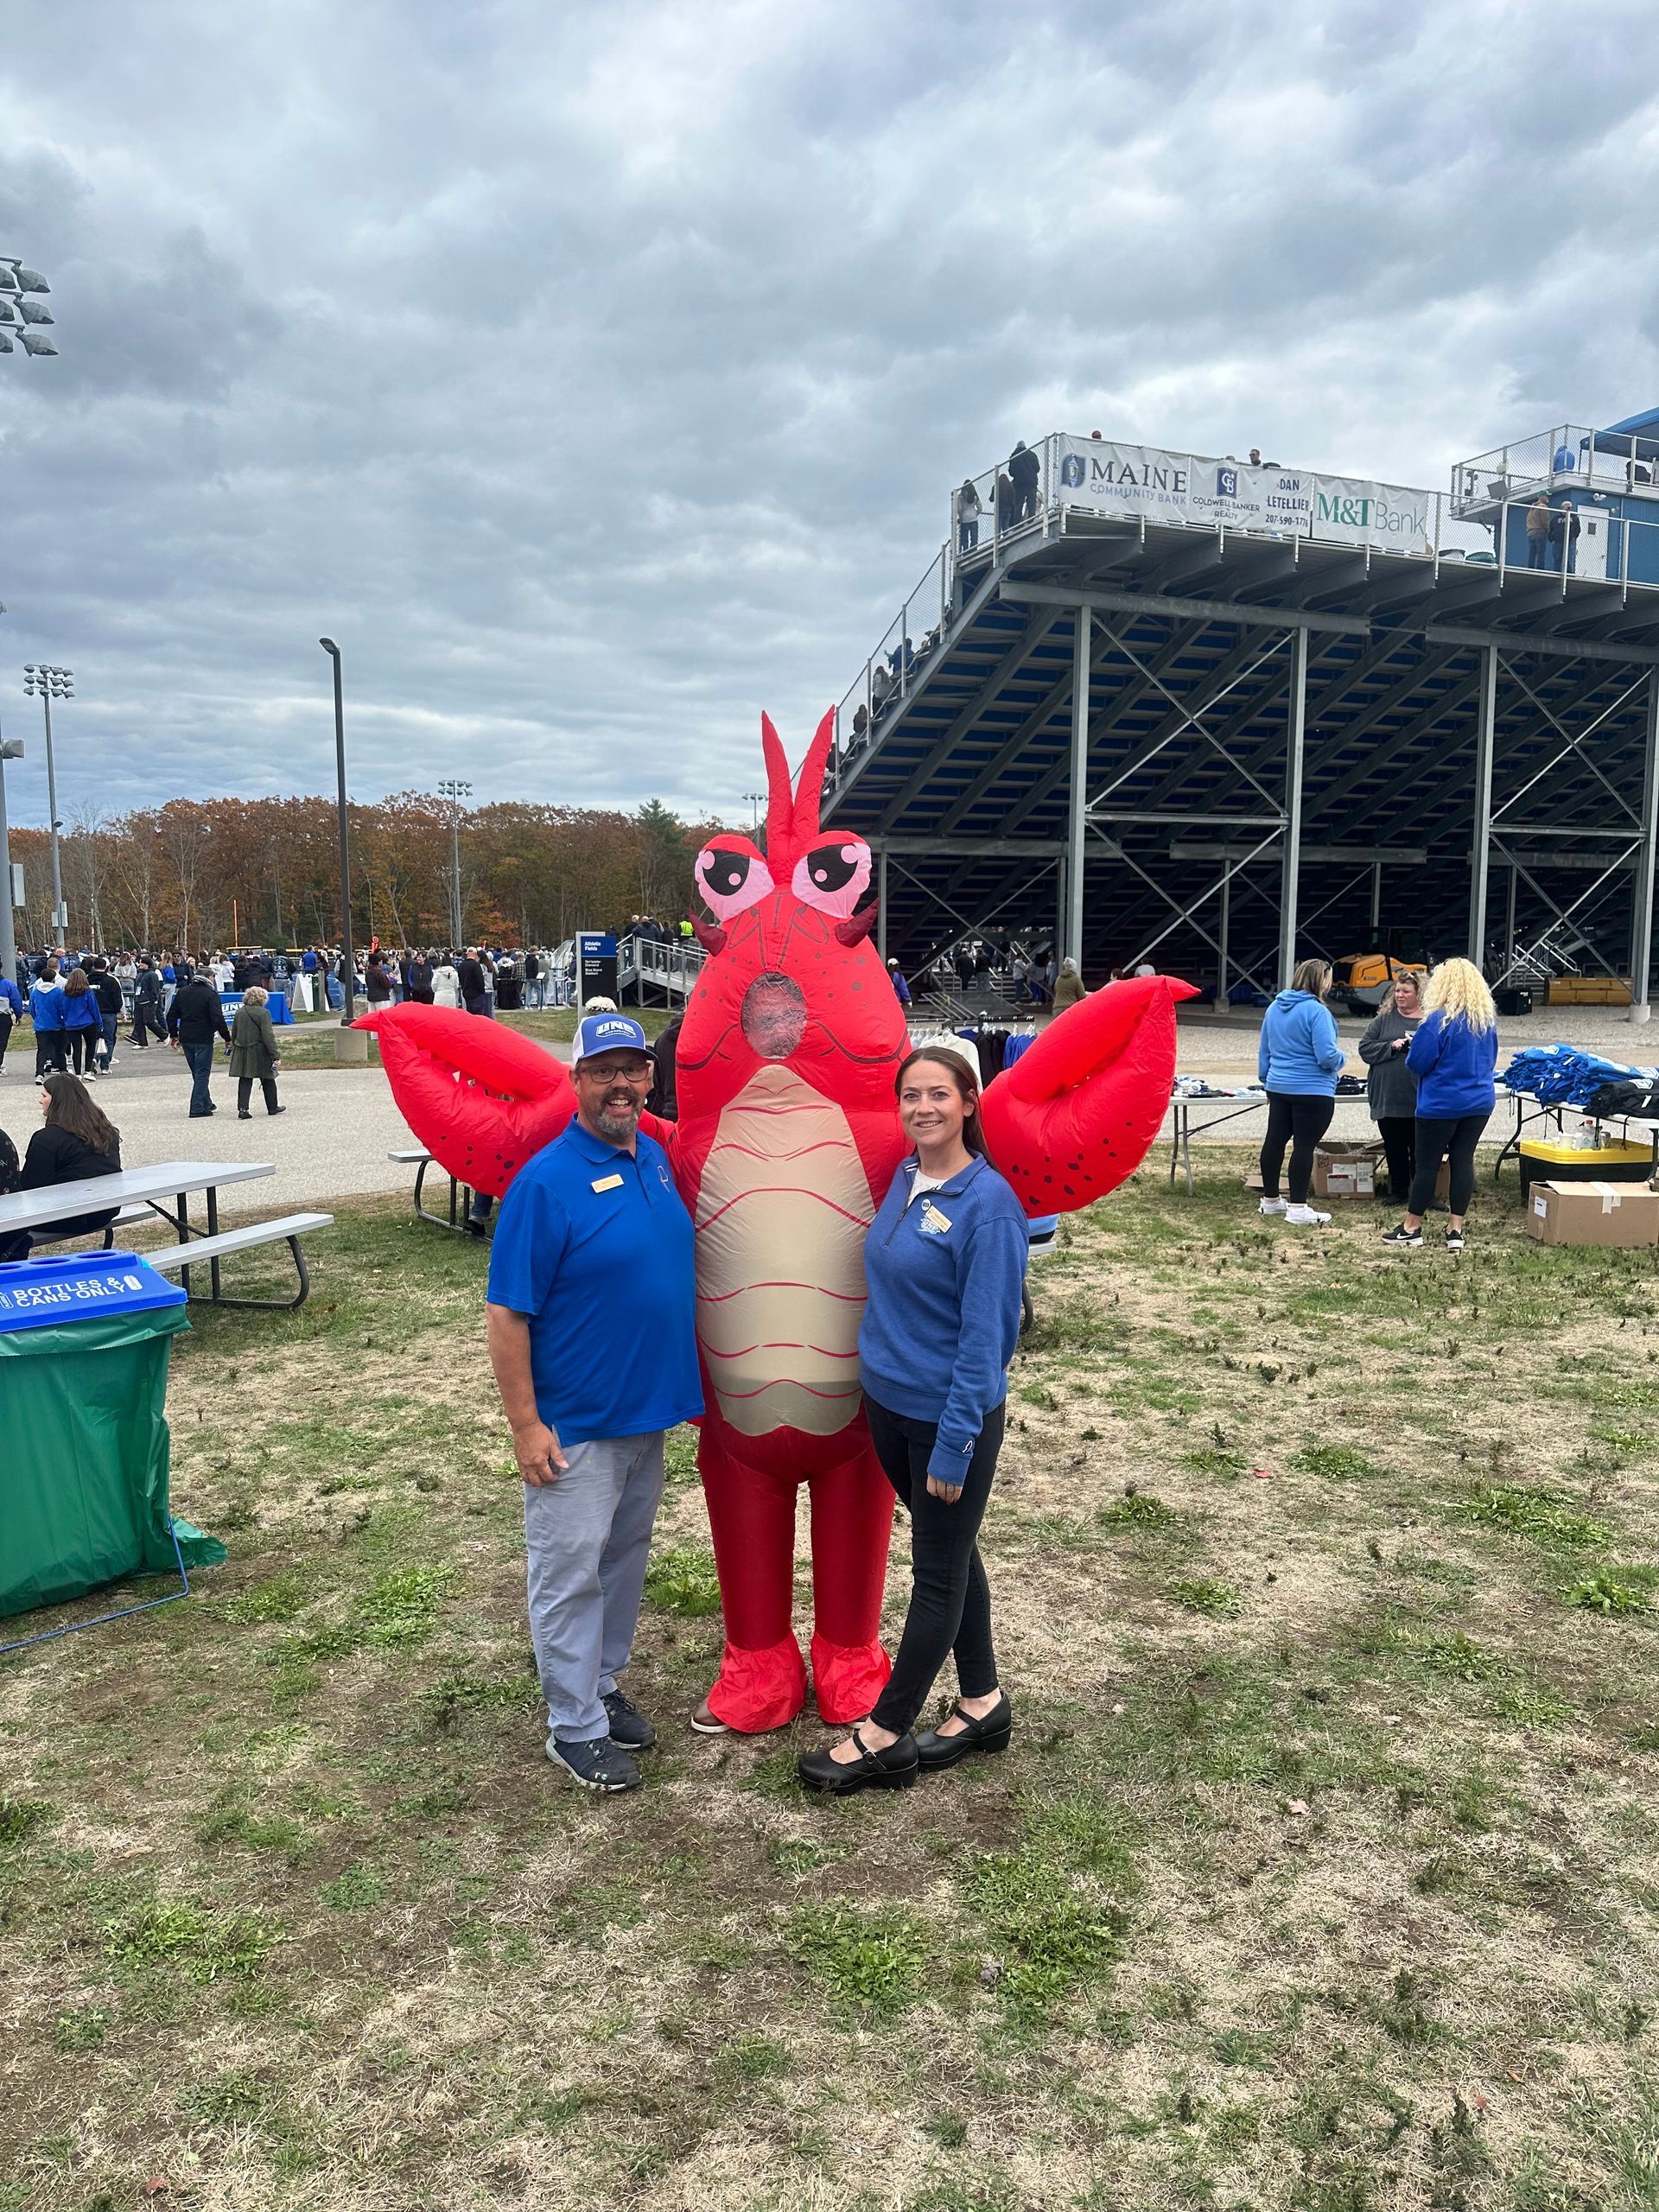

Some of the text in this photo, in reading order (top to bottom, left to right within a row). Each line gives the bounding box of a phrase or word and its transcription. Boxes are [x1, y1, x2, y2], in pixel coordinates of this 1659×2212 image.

[1090, 458, 1187, 493] MAINE
[1280, 479, 1300, 491] DAN
[1090, 483, 1187, 505] COMMUNITY BANK
[1192, 497, 1260, 512] COLDWELL BANKER
[1267, 495, 1310, 512] LETELLIER
[1214, 511, 1238, 519] REALTY
[1265, 514, 1308, 527] 207-590-1776
[1316, 493, 1425, 535] M&T Bank
[596, 1020, 637, 1035] UNE
[12, 1277, 121, 1300] BOTTLES &
[16, 1283, 125, 1307] CANS ONLY
